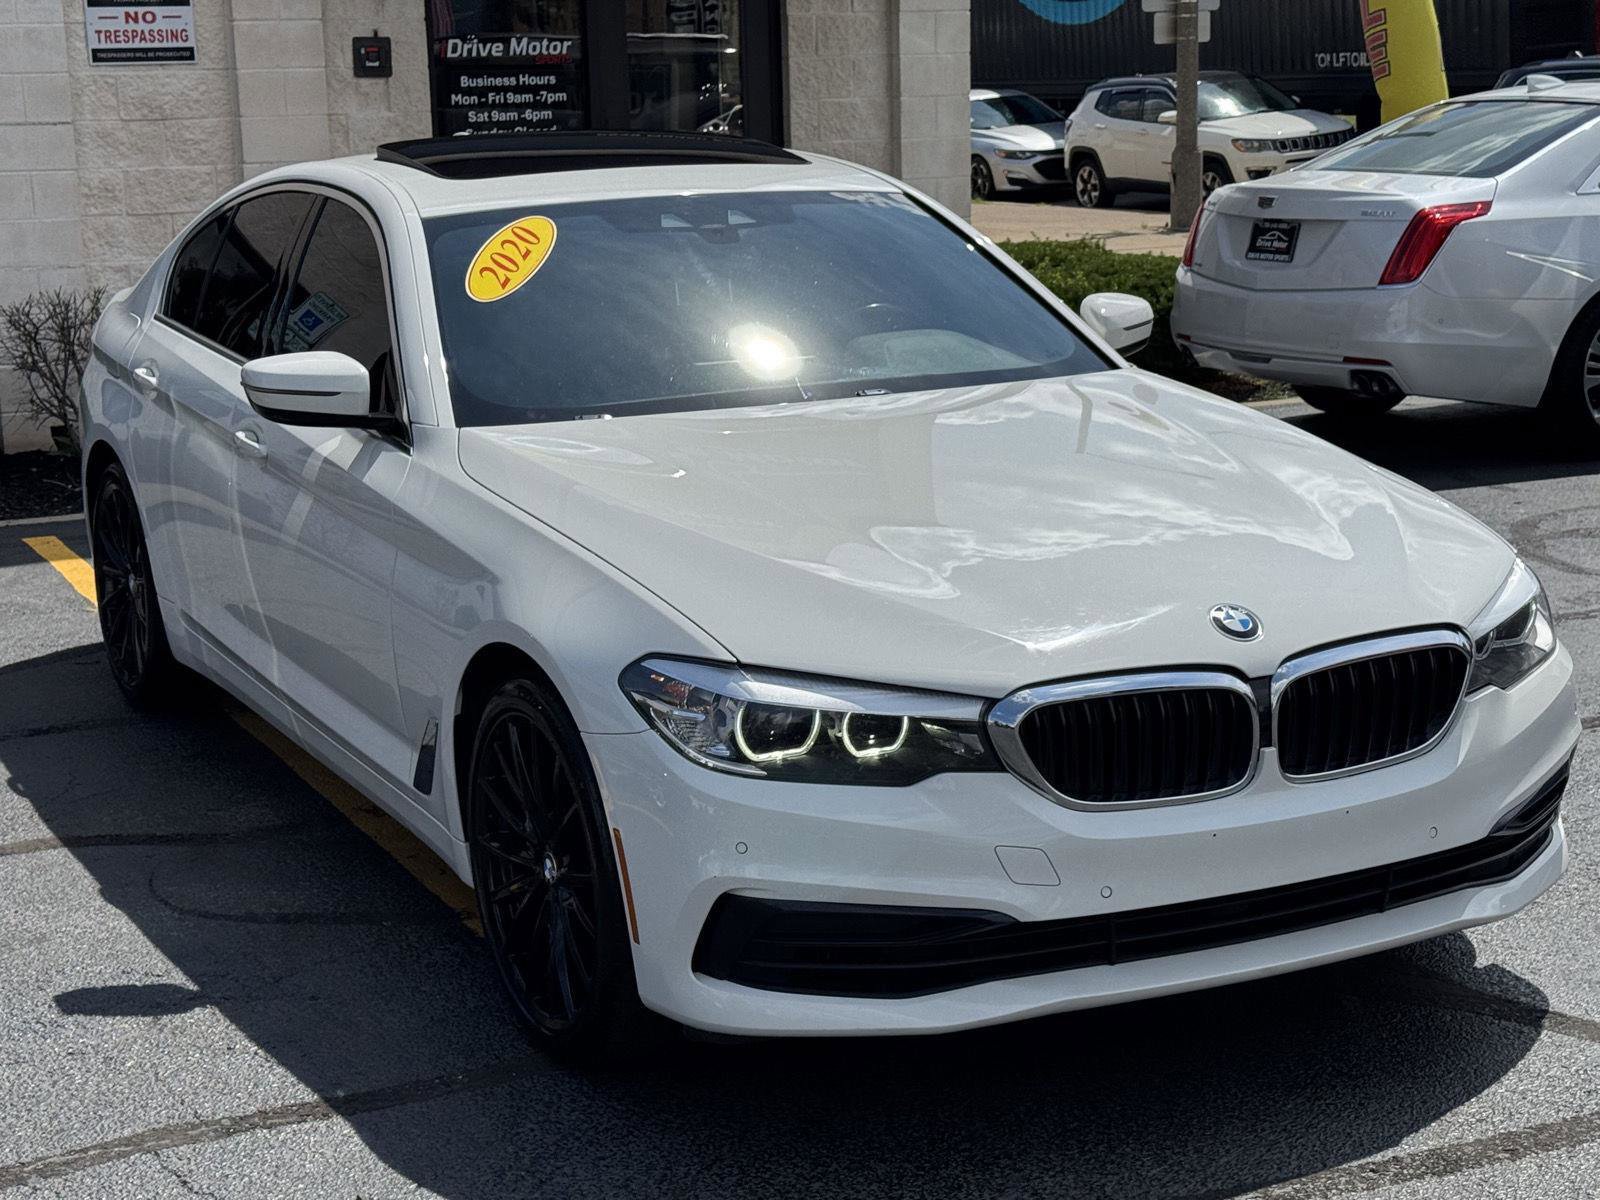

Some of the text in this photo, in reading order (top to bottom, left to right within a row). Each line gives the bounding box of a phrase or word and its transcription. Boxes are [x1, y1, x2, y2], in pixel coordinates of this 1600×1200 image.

[124, 10, 157, 25] NO
[95, 28, 189, 44] TRESPASSING
[446, 37, 572, 58] Drive Motor
[460, 74, 556, 87] Business Hours
[450, 93, 479, 106] Mon
[488, 92, 504, 104] Fri
[506, 92, 534, 104] 9am
[467, 110, 489, 123] Sat
[491, 110, 518, 122] 9am
[479, 226, 541, 290] 2020
